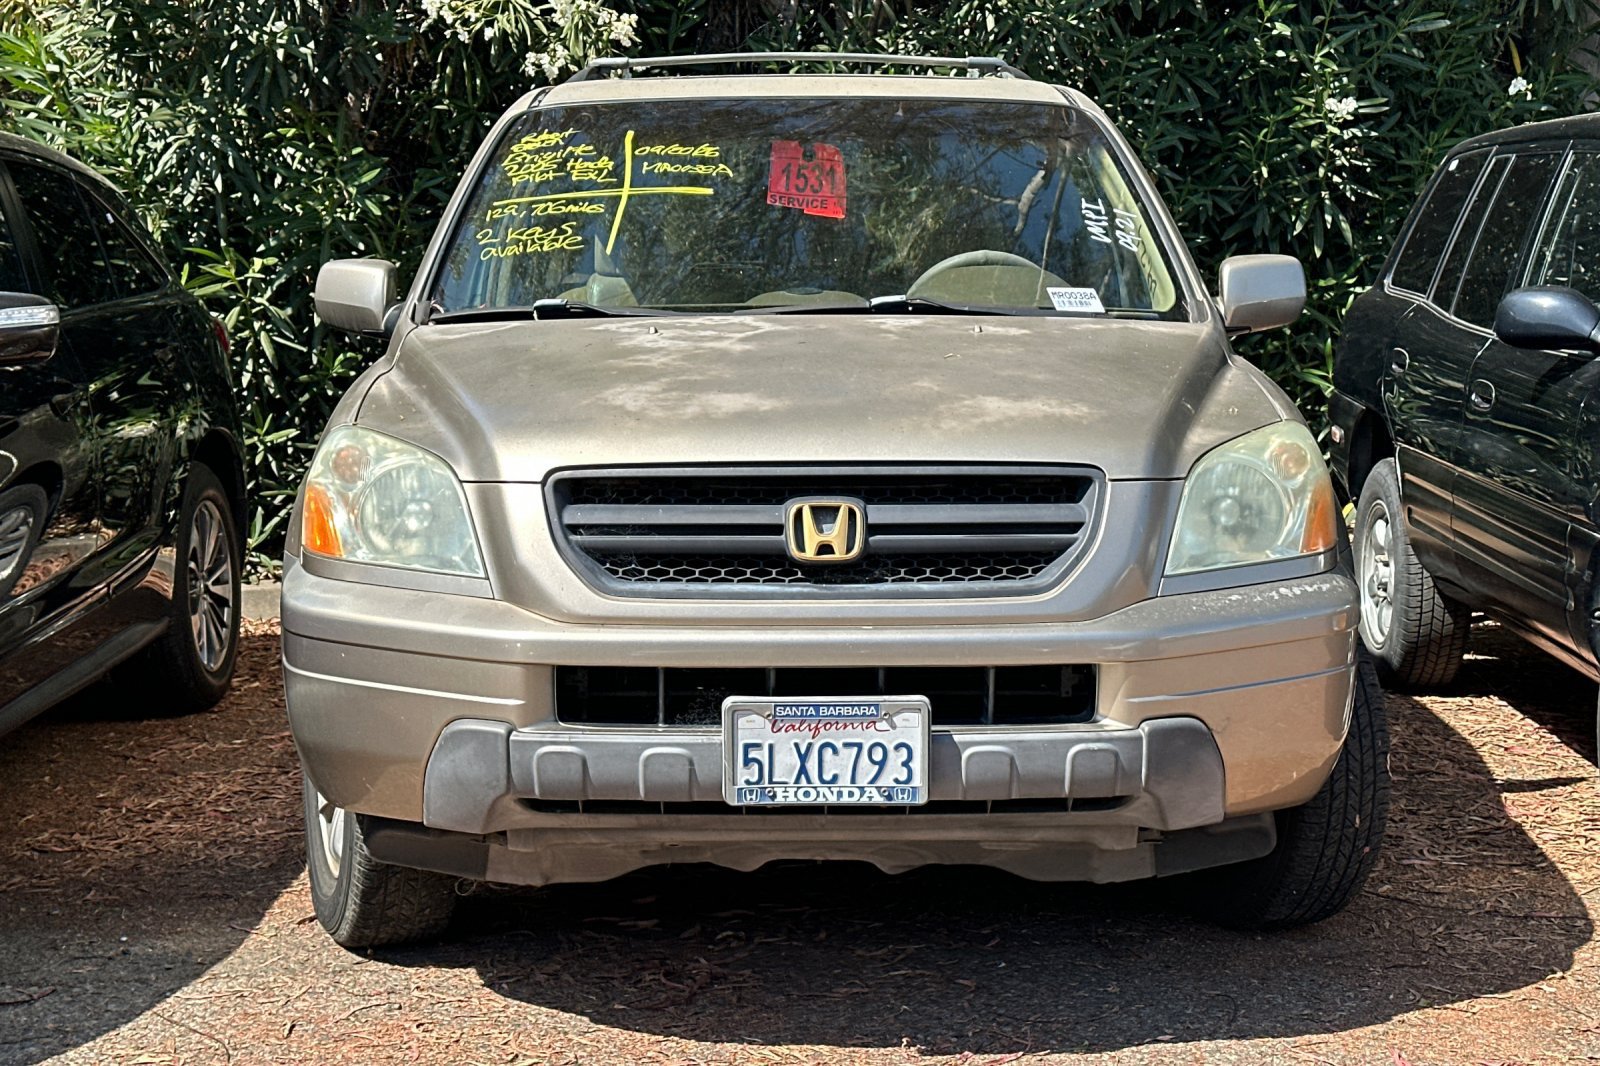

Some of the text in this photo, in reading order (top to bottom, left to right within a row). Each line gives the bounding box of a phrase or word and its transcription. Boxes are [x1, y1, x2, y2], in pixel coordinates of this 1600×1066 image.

[781, 162, 837, 195] 1531
[769, 193, 829, 209] SERVICE
[1081, 197, 1113, 244] MPI
[475, 228, 501, 245] 2
[1050, 291, 1097, 300] MR0038A
[776, 705, 878, 717] SANTA BARBARA
[770, 718, 891, 740] California
[741, 741, 914, 787] 5LXC793
[773, 786, 883, 803] HONDA
